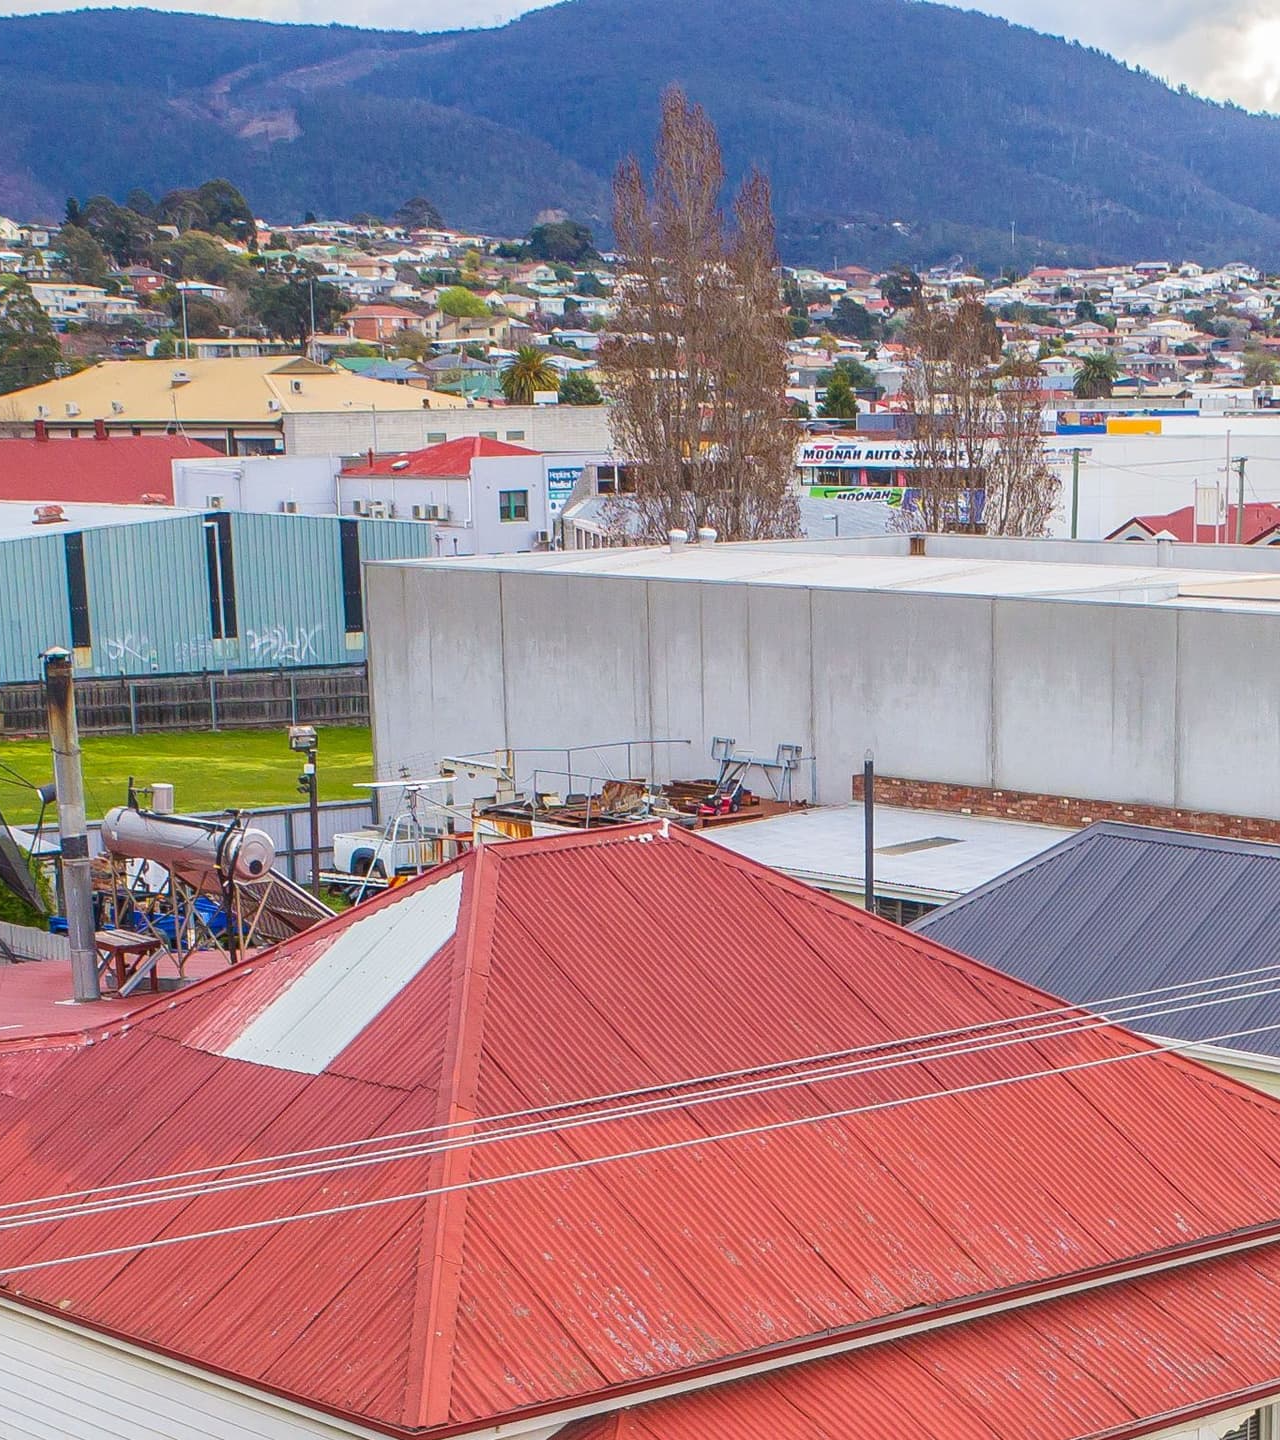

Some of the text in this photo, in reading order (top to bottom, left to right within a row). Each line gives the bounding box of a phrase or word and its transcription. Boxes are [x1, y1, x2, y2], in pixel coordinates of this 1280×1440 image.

[803, 449, 861, 460] MOONAH
[865, 449, 900, 460] AUTO
[837, 489, 891, 501] MOONAH
